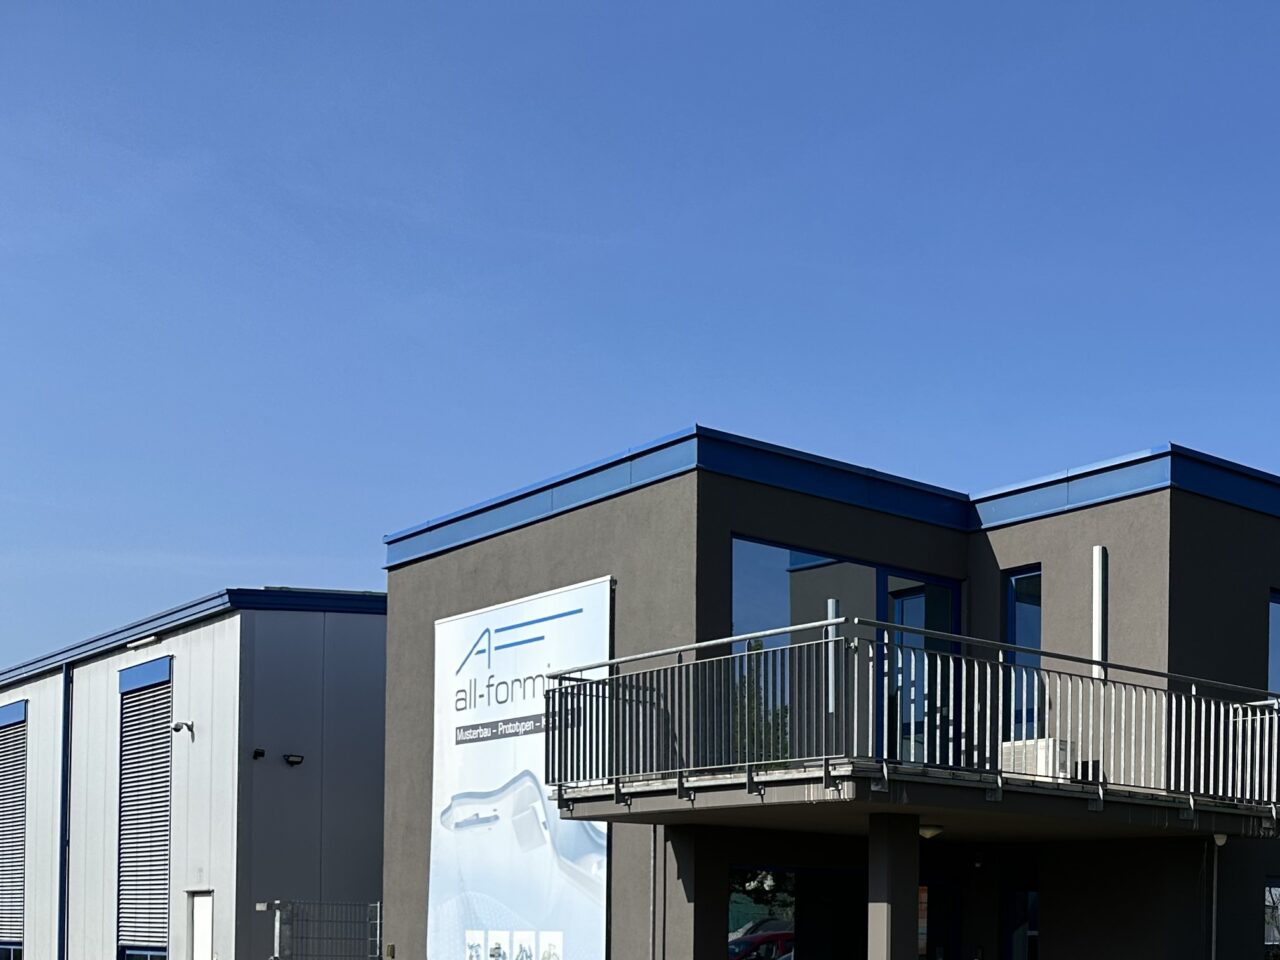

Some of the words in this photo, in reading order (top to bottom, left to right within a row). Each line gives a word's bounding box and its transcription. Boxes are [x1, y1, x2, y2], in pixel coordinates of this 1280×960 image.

[455, 662, 553, 712] all-formi
[456, 726, 492, 741] Musterbau
[498, 720, 534, 735] Prototypen
